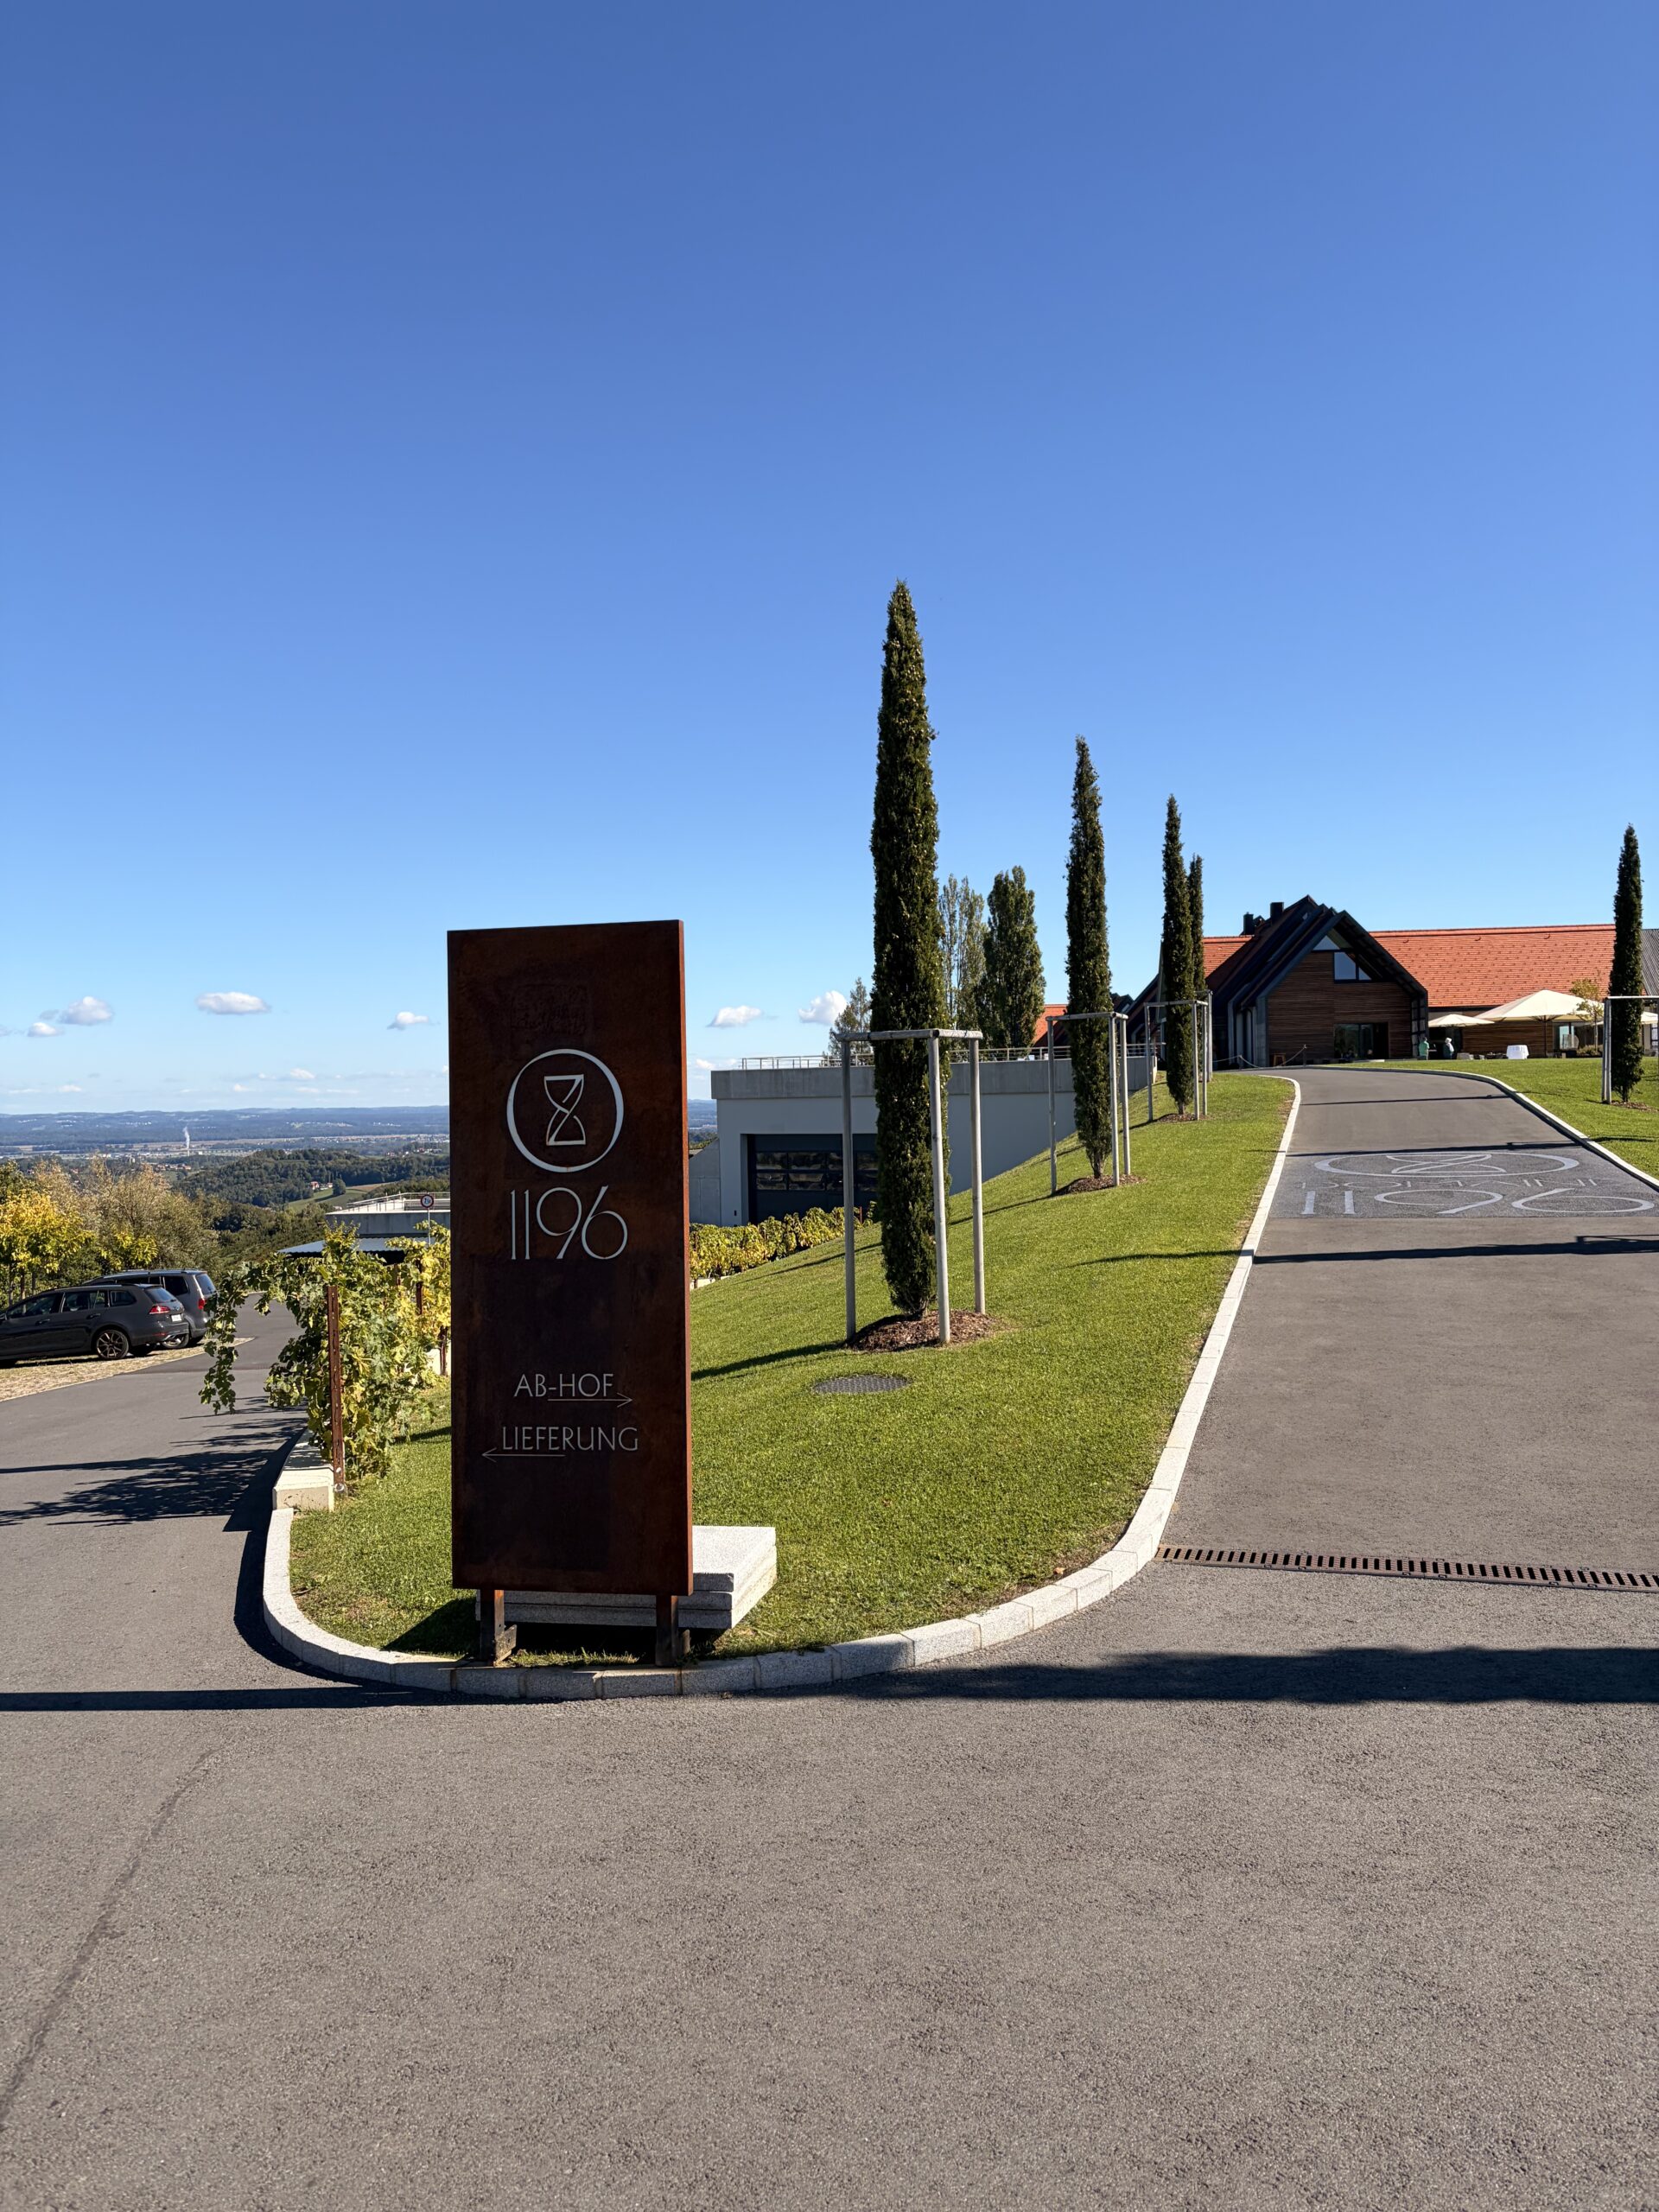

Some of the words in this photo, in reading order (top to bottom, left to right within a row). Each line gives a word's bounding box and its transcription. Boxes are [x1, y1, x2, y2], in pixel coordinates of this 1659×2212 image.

[1301, 1188, 1655, 1214] 1196
[511, 1185, 628, 1260] 1196
[514, 1373, 614, 1397] AB-HOF
[502, 1426, 639, 1452] LIEFERUNG
